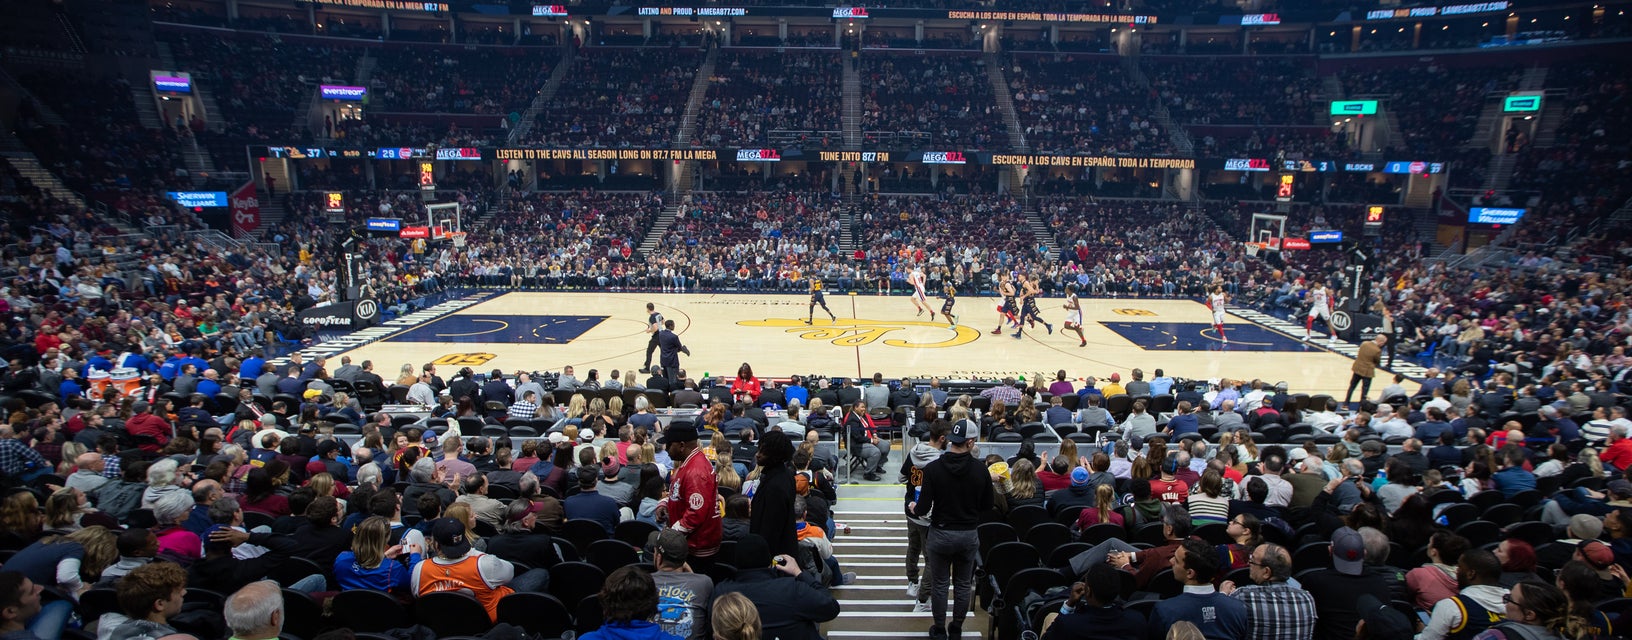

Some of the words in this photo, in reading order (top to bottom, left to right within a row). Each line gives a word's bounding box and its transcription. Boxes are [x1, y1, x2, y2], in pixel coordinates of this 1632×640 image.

[424, 3, 438, 11] 87.7
[438, 4, 449, 12] FM
[638, 7, 659, 15] LATINO
[660, 7, 672, 15] AND
[673, 7, 693, 16] PROUD
[697, 8, 745, 16] LAMEGA877.COM
[948, 11, 975, 19] ESCUCHA
[976, 11, 981, 19] A
[992, 12, 1007, 20] CAVS
[1008, 12, 1016, 20] EN
[1016, 12, 1042, 21] ESPAÑOL
[1042, 13, 1058, 21] TODA
[1066, 14, 1101, 22] TEMPORADA
[1101, 15, 1110, 23] EN
[1111, 15, 1118, 23] LA
[1118, 15, 1134, 23] MEGA
[1135, 16, 1147, 24] 87.7
[1148, 16, 1158, 24] FM
[1366, 10, 1394, 20] LATINO
[1410, 7, 1437, 17] PROUD
[323, 88, 363, 96] everstream
[306, 148, 320, 158] 37
[382, 149, 395, 158] 29
[437, 150, 462, 158] MEGA
[496, 149, 523, 159] LISTEN
[524, 149, 534, 159] TO
[536, 149, 551, 159] THE
[552, 149, 571, 159] CAVS
[573, 149, 586, 159] ALL
[587, 149, 617, 159] SEASON
[619, 150, 638, 159] LONG
[640, 150, 650, 159] ON
[653, 150, 668, 159] 87.7
[670, 150, 682, 160] FM
[683, 150, 693, 160] LA
[694, 150, 717, 160] MEGA
[737, 151, 761, 159] MEGA
[820, 151, 839, 161] TUNE
[841, 151, 860, 161] INTO
[862, 152, 876, 162] 87.7
[877, 152, 889, 162] FM
[923, 153, 947, 161] MEGA
[992, 155, 1027, 165] ESCUCHA
[1028, 155, 1034, 165] A
[1035, 156, 1049, 165] LOS
[1051, 156, 1070, 166] CAVS
[1072, 156, 1082, 166] EN
[1083, 156, 1117, 167] ESPAÑOL
[1118, 157, 1138, 167] TODA
[1139, 158, 1148, 168] LA
[1150, 158, 1195, 169] TEMPORADA
[1225, 160, 1250, 168] MEGA
[1319, 162, 1328, 171] 3
[1345, 163, 1374, 171] BLOCKS
[1392, 163, 1400, 173] 0
[421, 172, 432, 184] 24
[1279, 184, 1292, 196] 24
[177, 192, 215, 200] SHERWIN
[1480, 208, 1519, 216] SHERWIN
[359, 303, 374, 316] KIA
[303, 316, 351, 326] GOODYEAR
[1333, 314, 1347, 328] KIA
[953, 424, 961, 434] G
